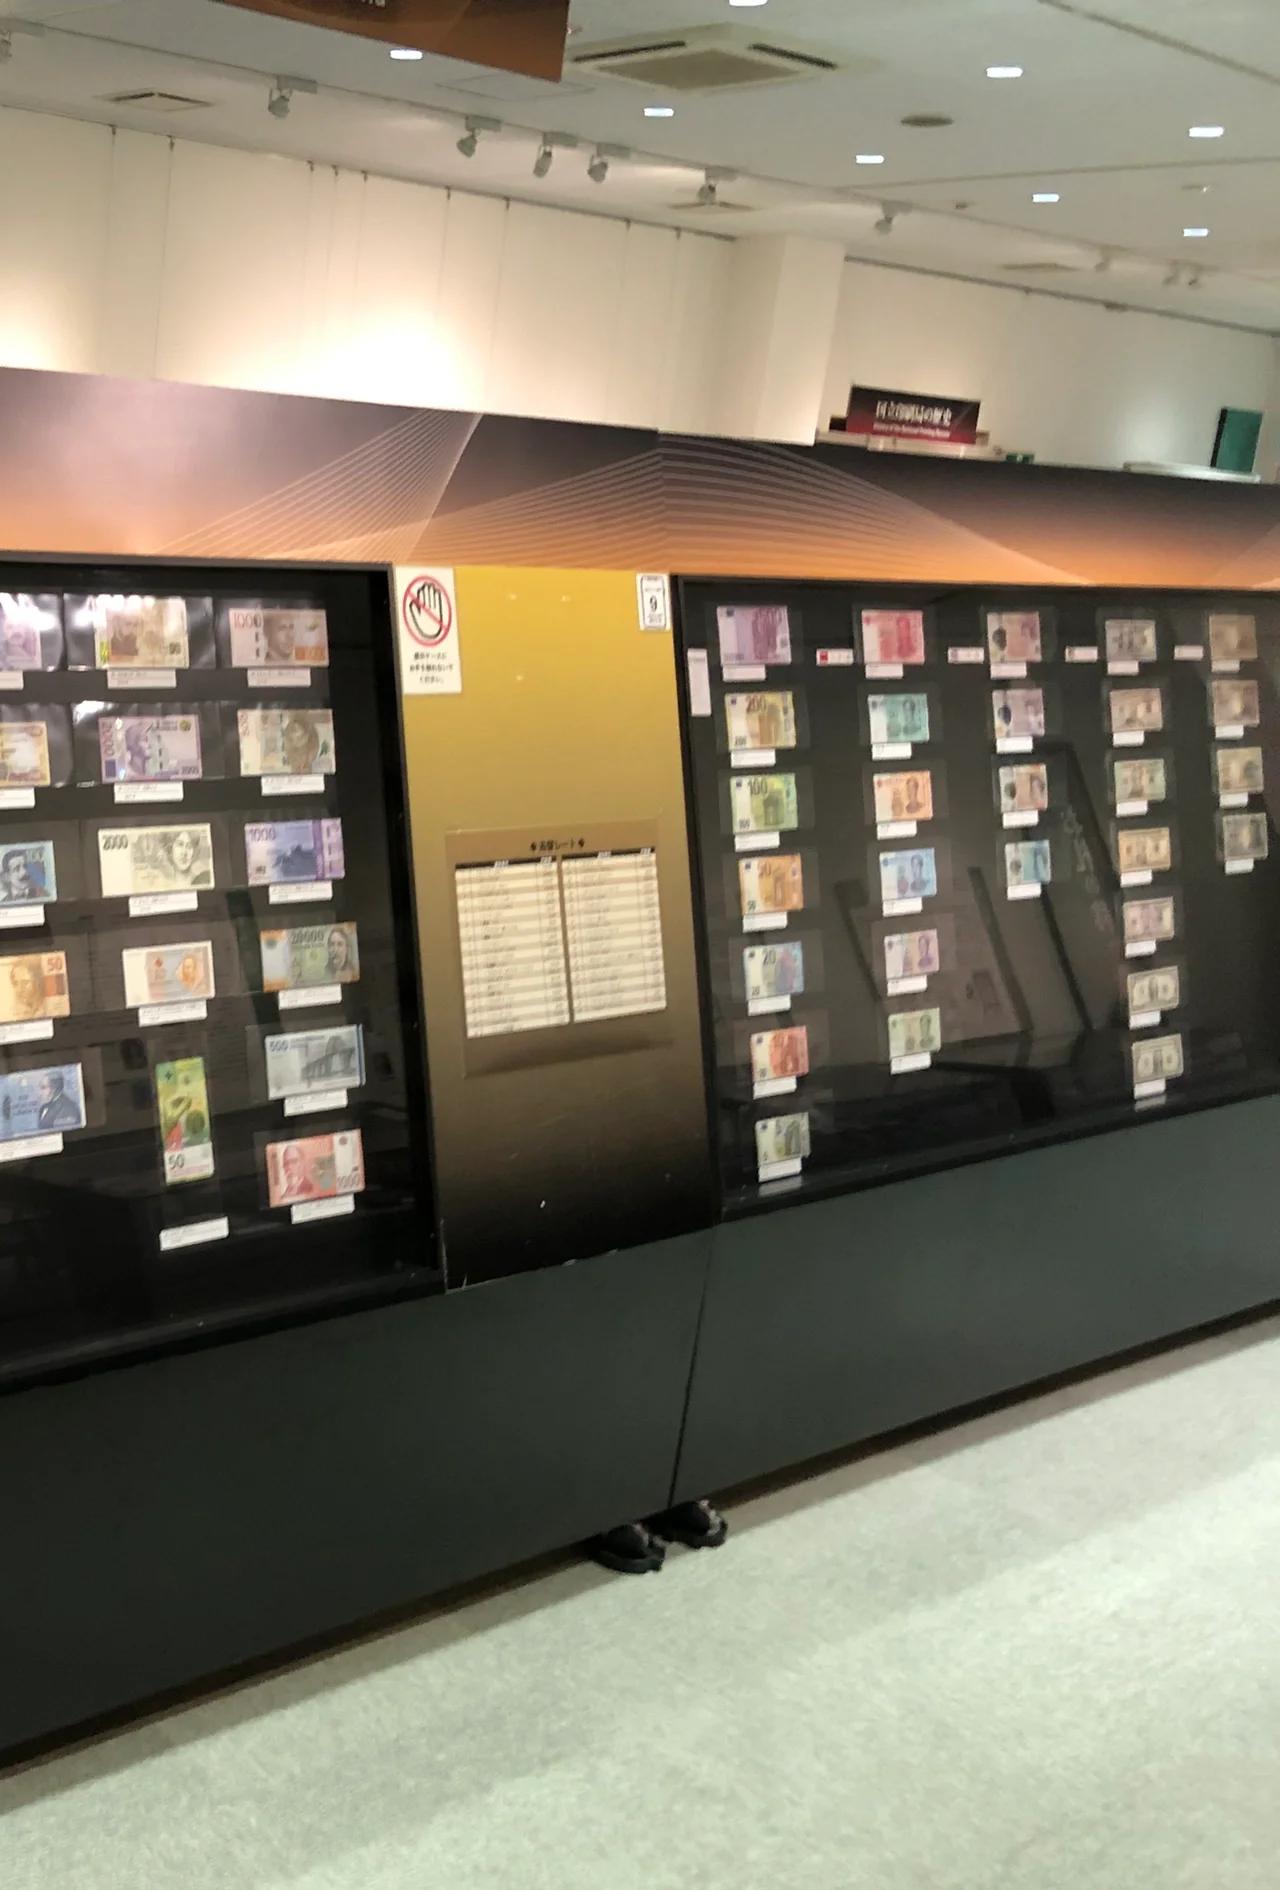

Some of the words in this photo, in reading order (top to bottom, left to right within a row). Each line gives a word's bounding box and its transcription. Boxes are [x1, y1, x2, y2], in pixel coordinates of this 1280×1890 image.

[649, 595, 658, 613] 9
[745, 694, 767, 714] 200
[747, 777, 768, 796] 100
[102, 834, 129, 851] 2000
[47, 958, 63, 972] 50
[763, 948, 777, 965] 20
[168, 1154, 185, 1171] 50
